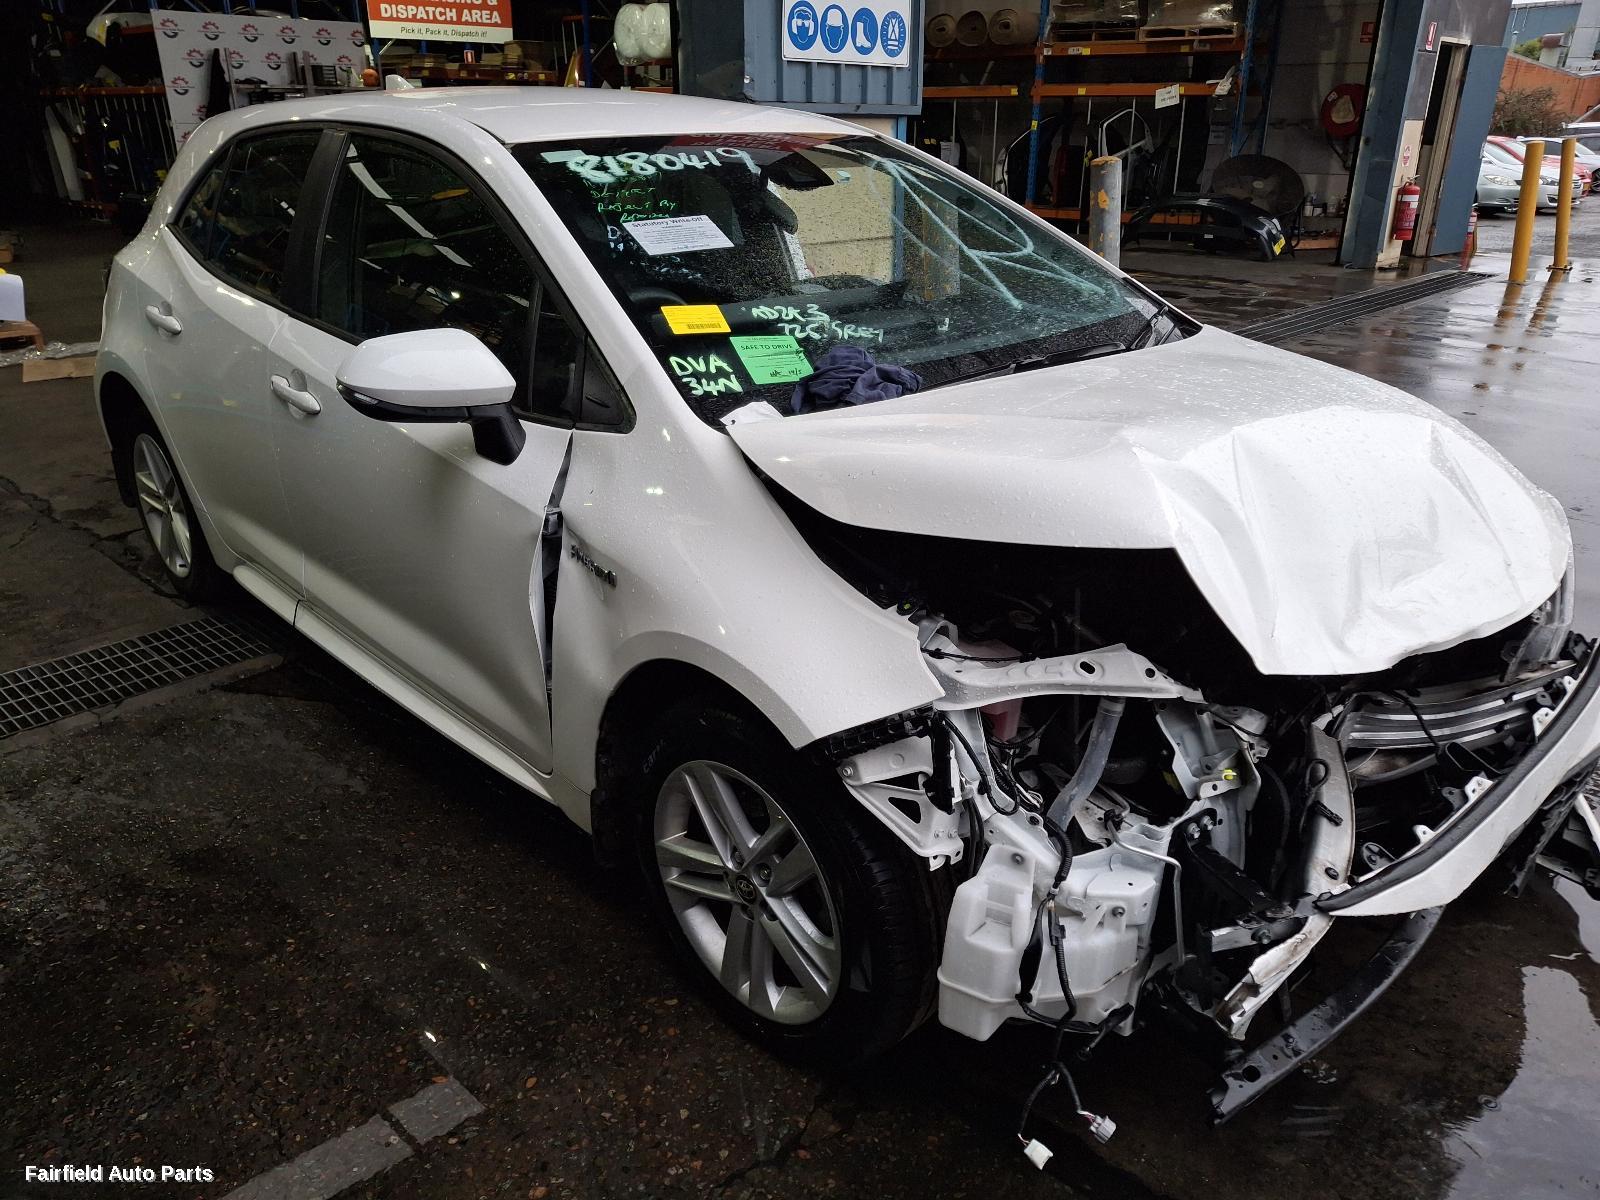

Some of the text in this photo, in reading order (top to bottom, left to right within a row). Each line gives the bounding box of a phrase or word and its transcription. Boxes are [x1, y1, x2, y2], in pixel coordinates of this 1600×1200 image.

[380, 3, 502, 24] DISPATCH AREA
[425, 27, 442, 35] Pack
[451, 29, 480, 38] Dispatch
[632, 219, 669, 229] Statutory
[668, 354, 733, 377] DVA
[682, 374, 743, 397] 34N
